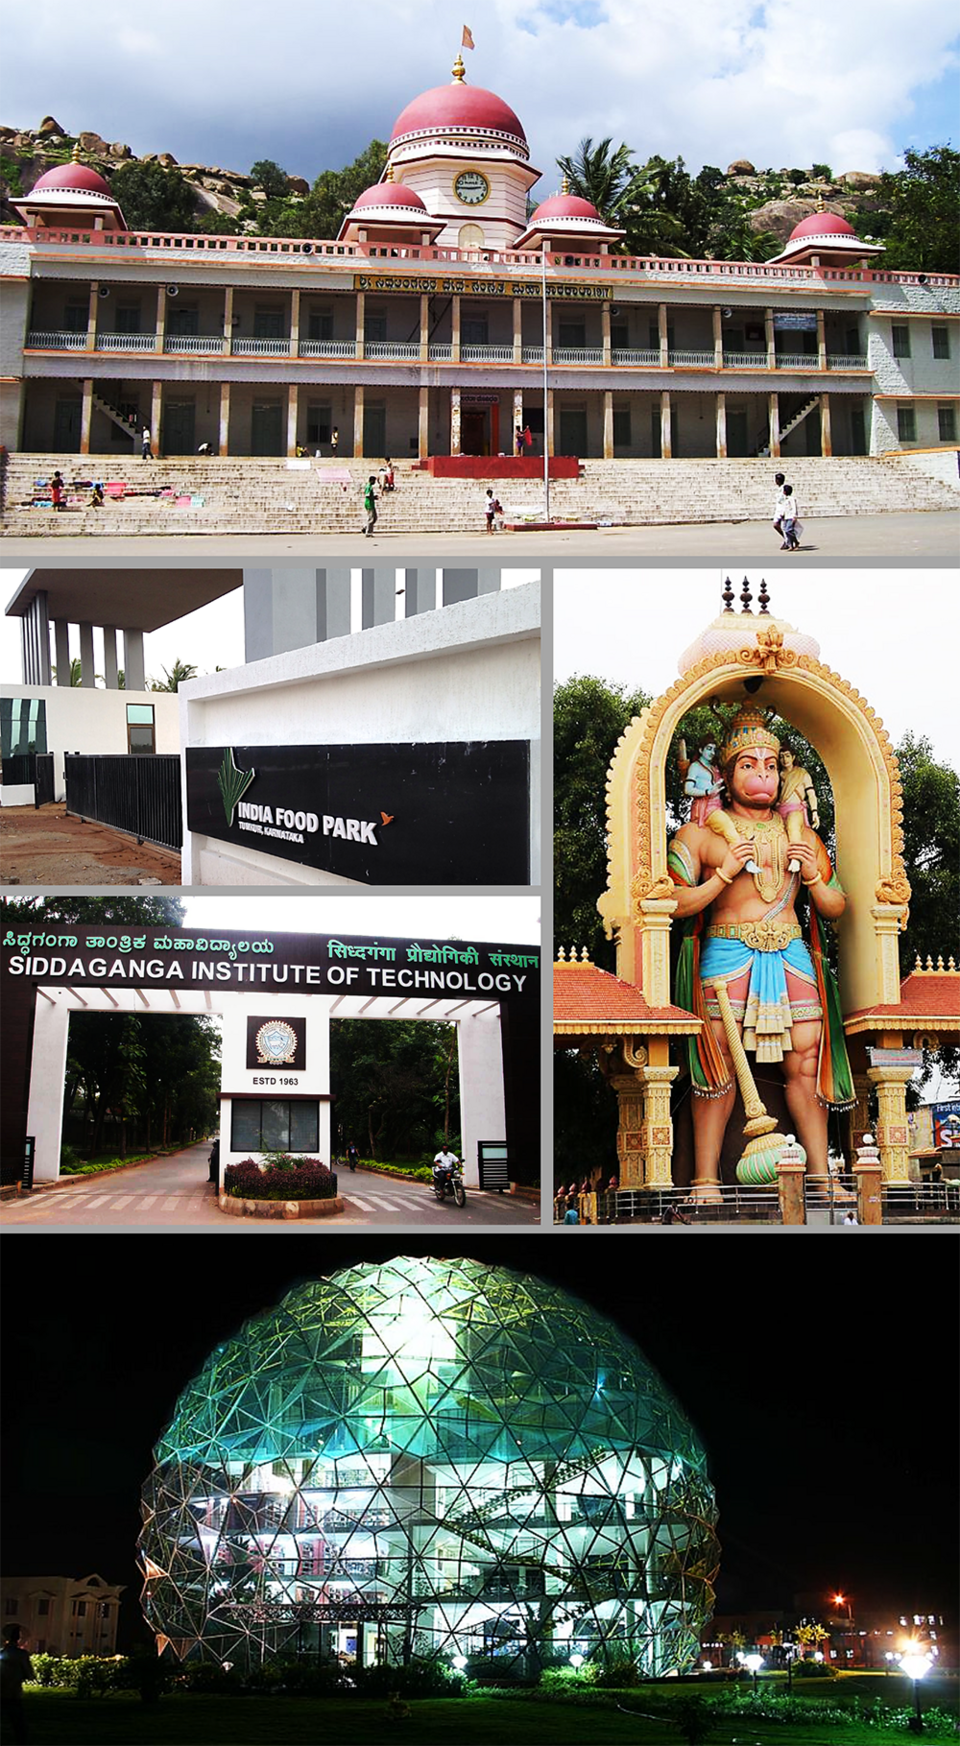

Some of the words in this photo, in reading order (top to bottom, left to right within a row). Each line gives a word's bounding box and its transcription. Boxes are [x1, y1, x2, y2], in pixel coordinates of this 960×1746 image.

[238, 802, 273, 824] INDIA
[275, 807, 319, 833] FOOD
[322, 815, 379, 846] PARK
[264, 826, 304, 844] KARNATAKA
[2, 930, 78, 955] ಸಿದ್ಧಗಂಗಾ
[85, 933, 147, 954] ತಾಂತ್ರಿಕ
[153, 934, 274, 961] ಮಹಾವಿದ್ಯಾಲಯ
[405, 942, 479, 966] प्रौद्योगिकी
[488, 949, 539, 968] संस्थान
[8, 955, 184, 980] SIDDAGANGA
[191, 961, 321, 985] INSTITUTE
[326, 966, 359, 986] OF
[366, 968, 527, 992] TECHNOLOGY
[252, 1077, 277, 1085] ESTD
[279, 1077, 299, 1086] 1963
